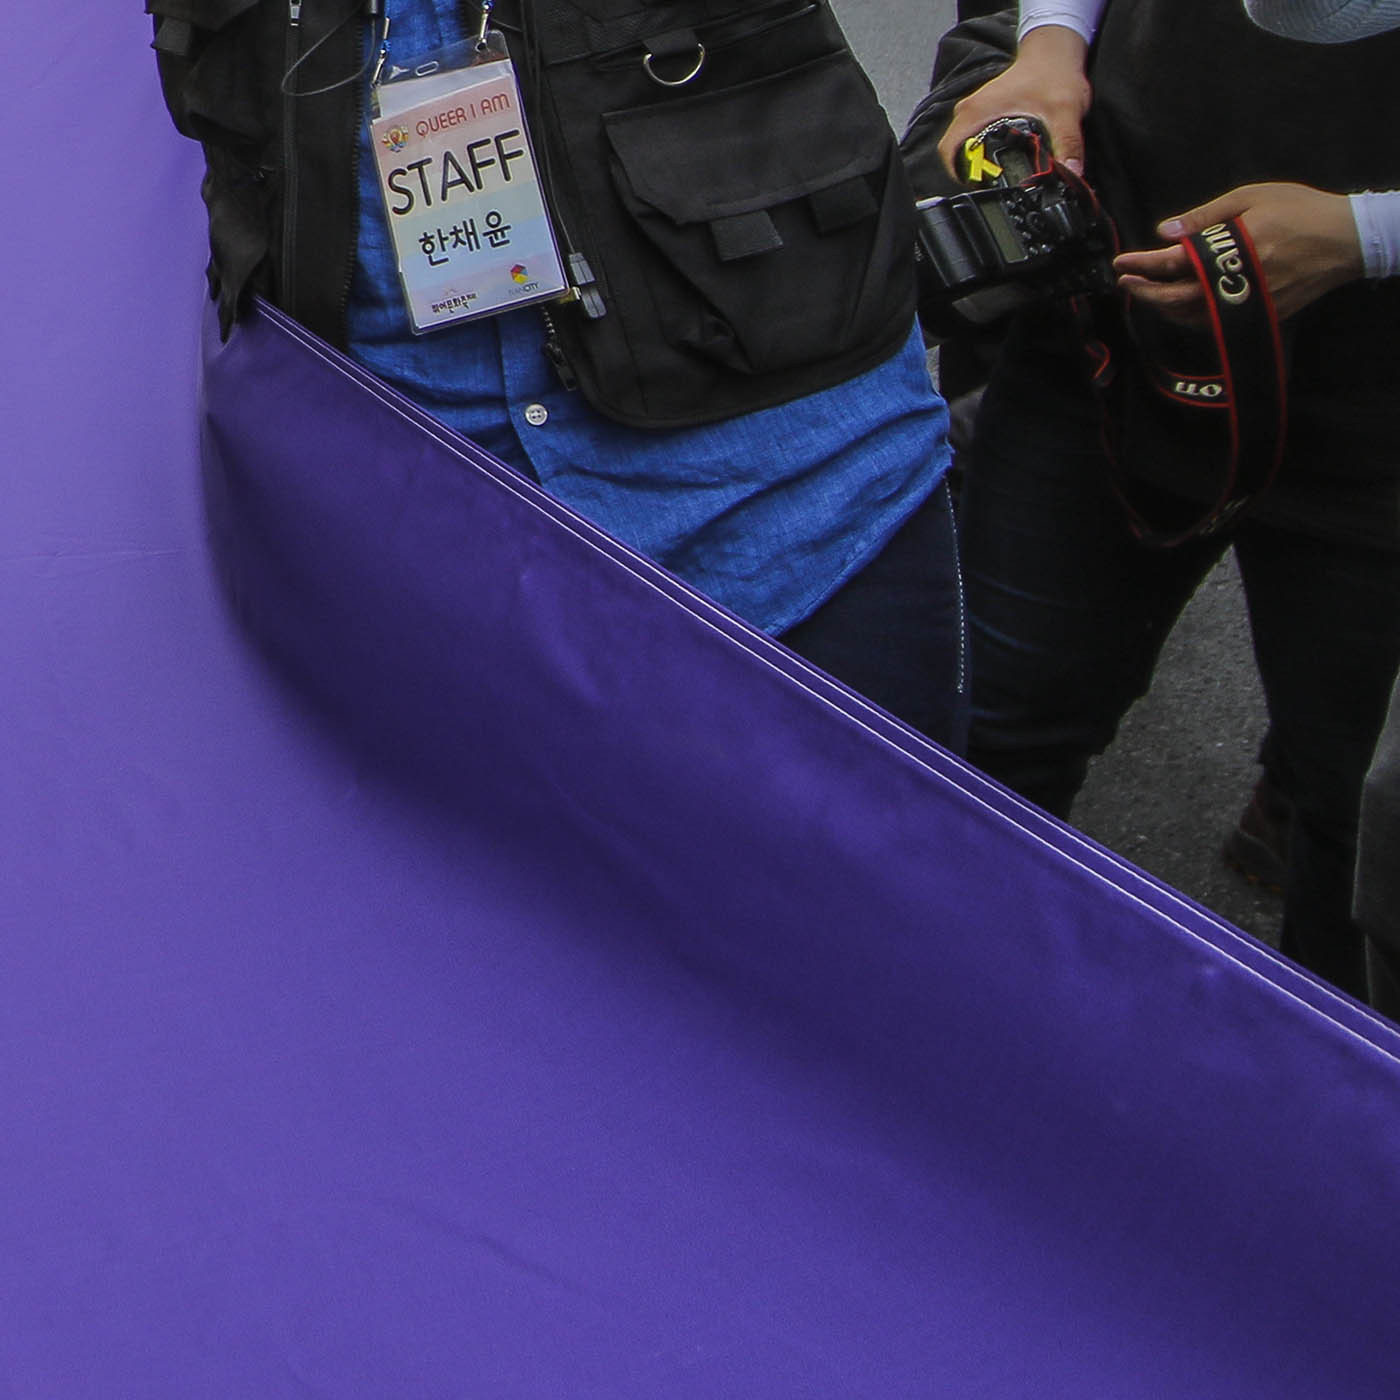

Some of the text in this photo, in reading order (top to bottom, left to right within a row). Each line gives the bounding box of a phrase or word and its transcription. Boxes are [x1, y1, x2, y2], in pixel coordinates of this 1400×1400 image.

[415, 92, 511, 138] QUEER I AM
[387, 128, 524, 216] STAFF
[418, 210, 512, 267] 한채윤
[1200, 222, 1251, 305] Cano
